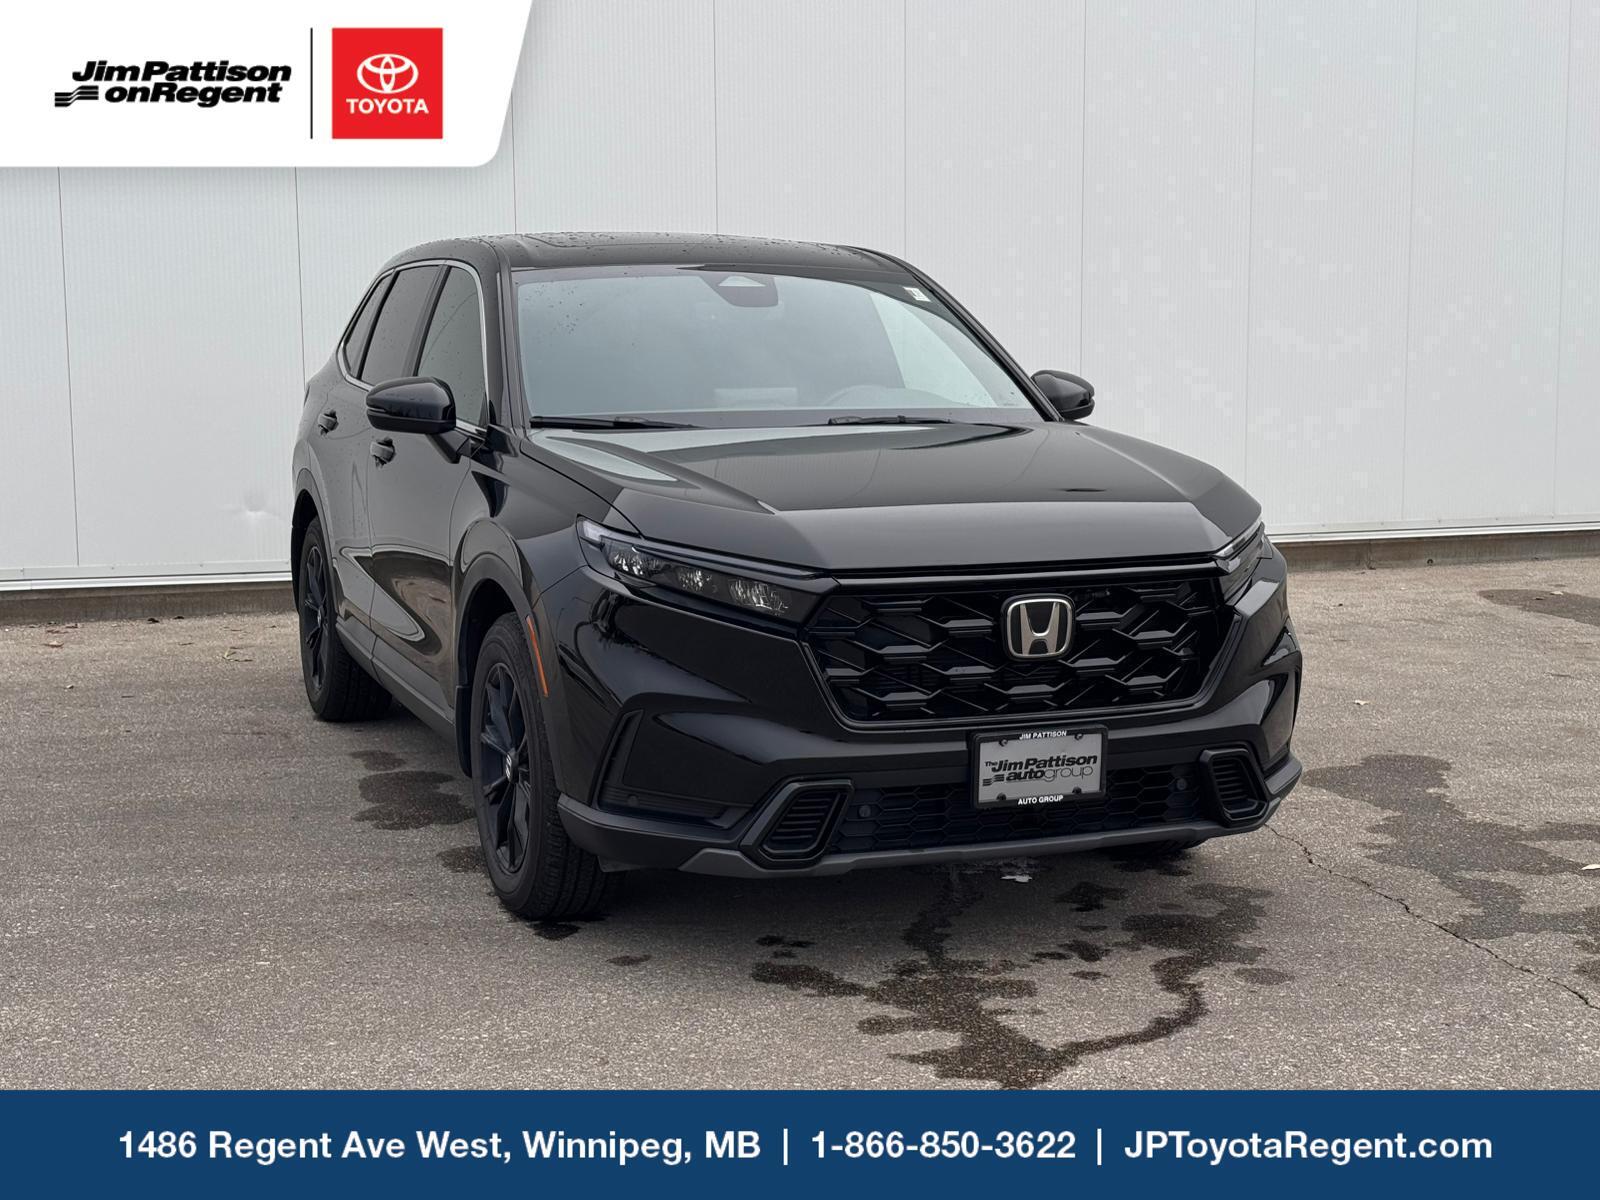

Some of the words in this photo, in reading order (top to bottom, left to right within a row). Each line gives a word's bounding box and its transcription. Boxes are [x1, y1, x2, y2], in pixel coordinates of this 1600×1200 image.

[1033, 730, 1067, 739] PATTISON
[1018, 797, 1037, 805] AUTO
[1039, 794, 1064, 803] GROUP
